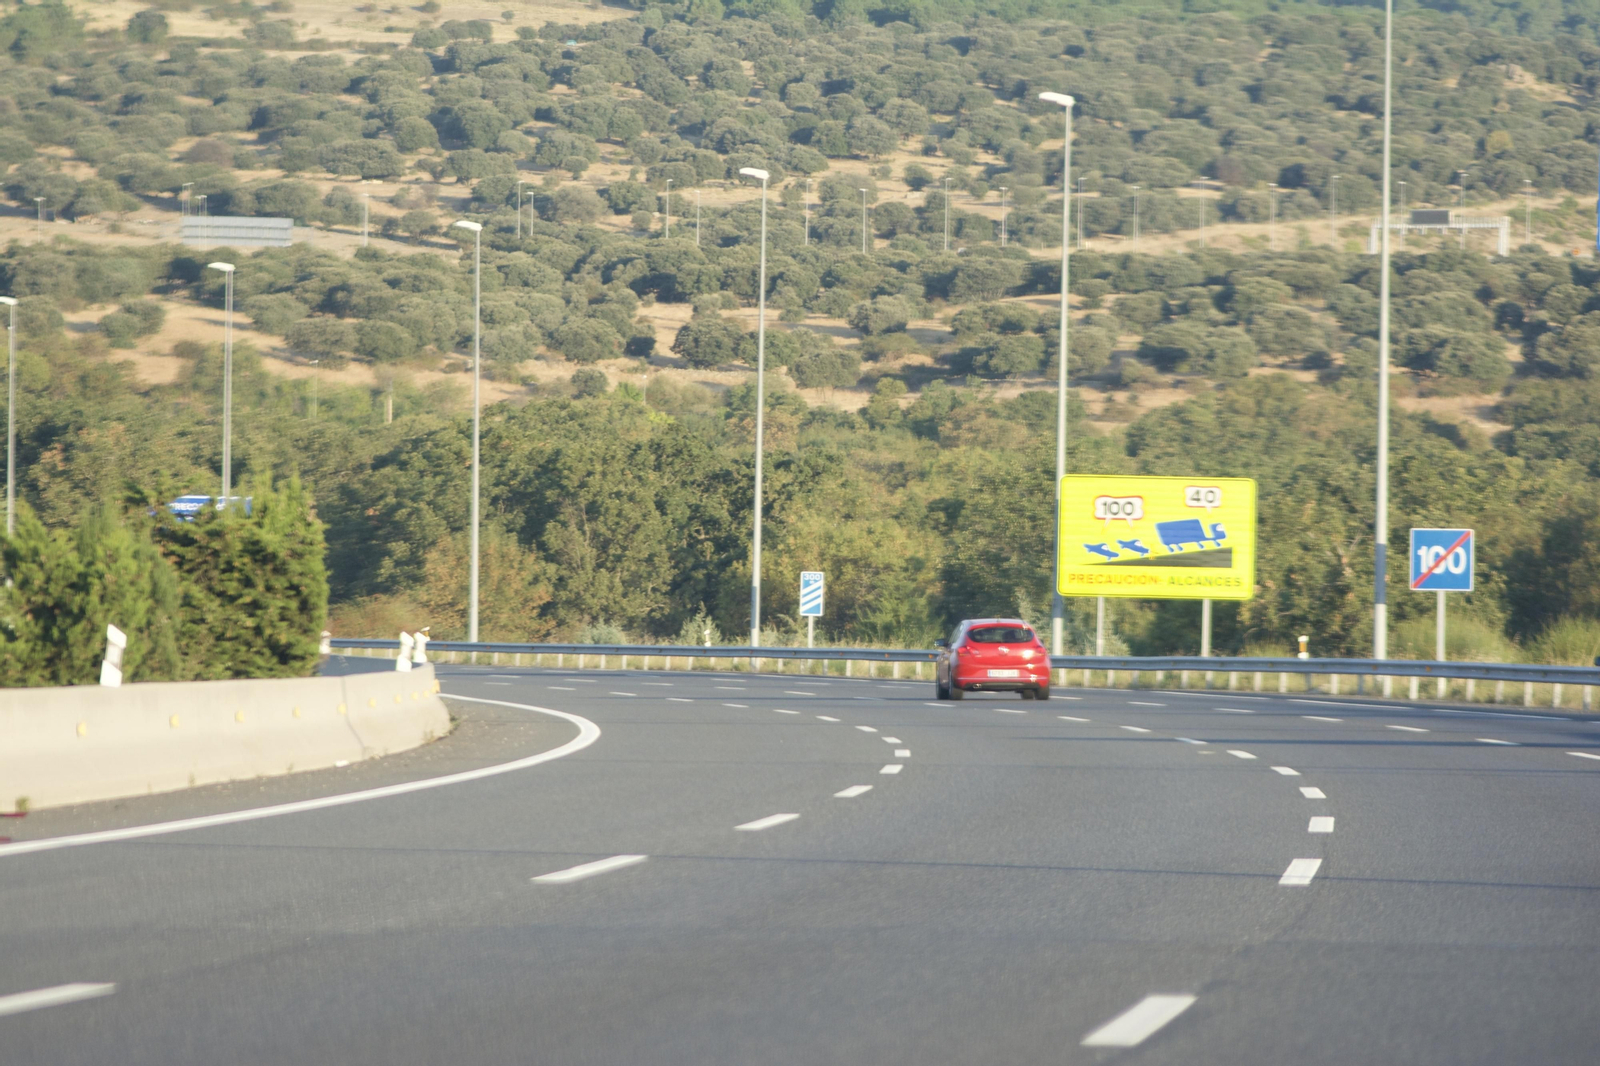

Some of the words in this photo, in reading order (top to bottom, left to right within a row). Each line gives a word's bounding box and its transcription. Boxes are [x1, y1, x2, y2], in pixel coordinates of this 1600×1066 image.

[1190, 489, 1216, 503] 40
[1102, 501, 1135, 516] 100
[1417, 545, 1467, 575] 100
[803, 573, 821, 581] 300
[1168, 576, 1242, 587] ALCANCES
